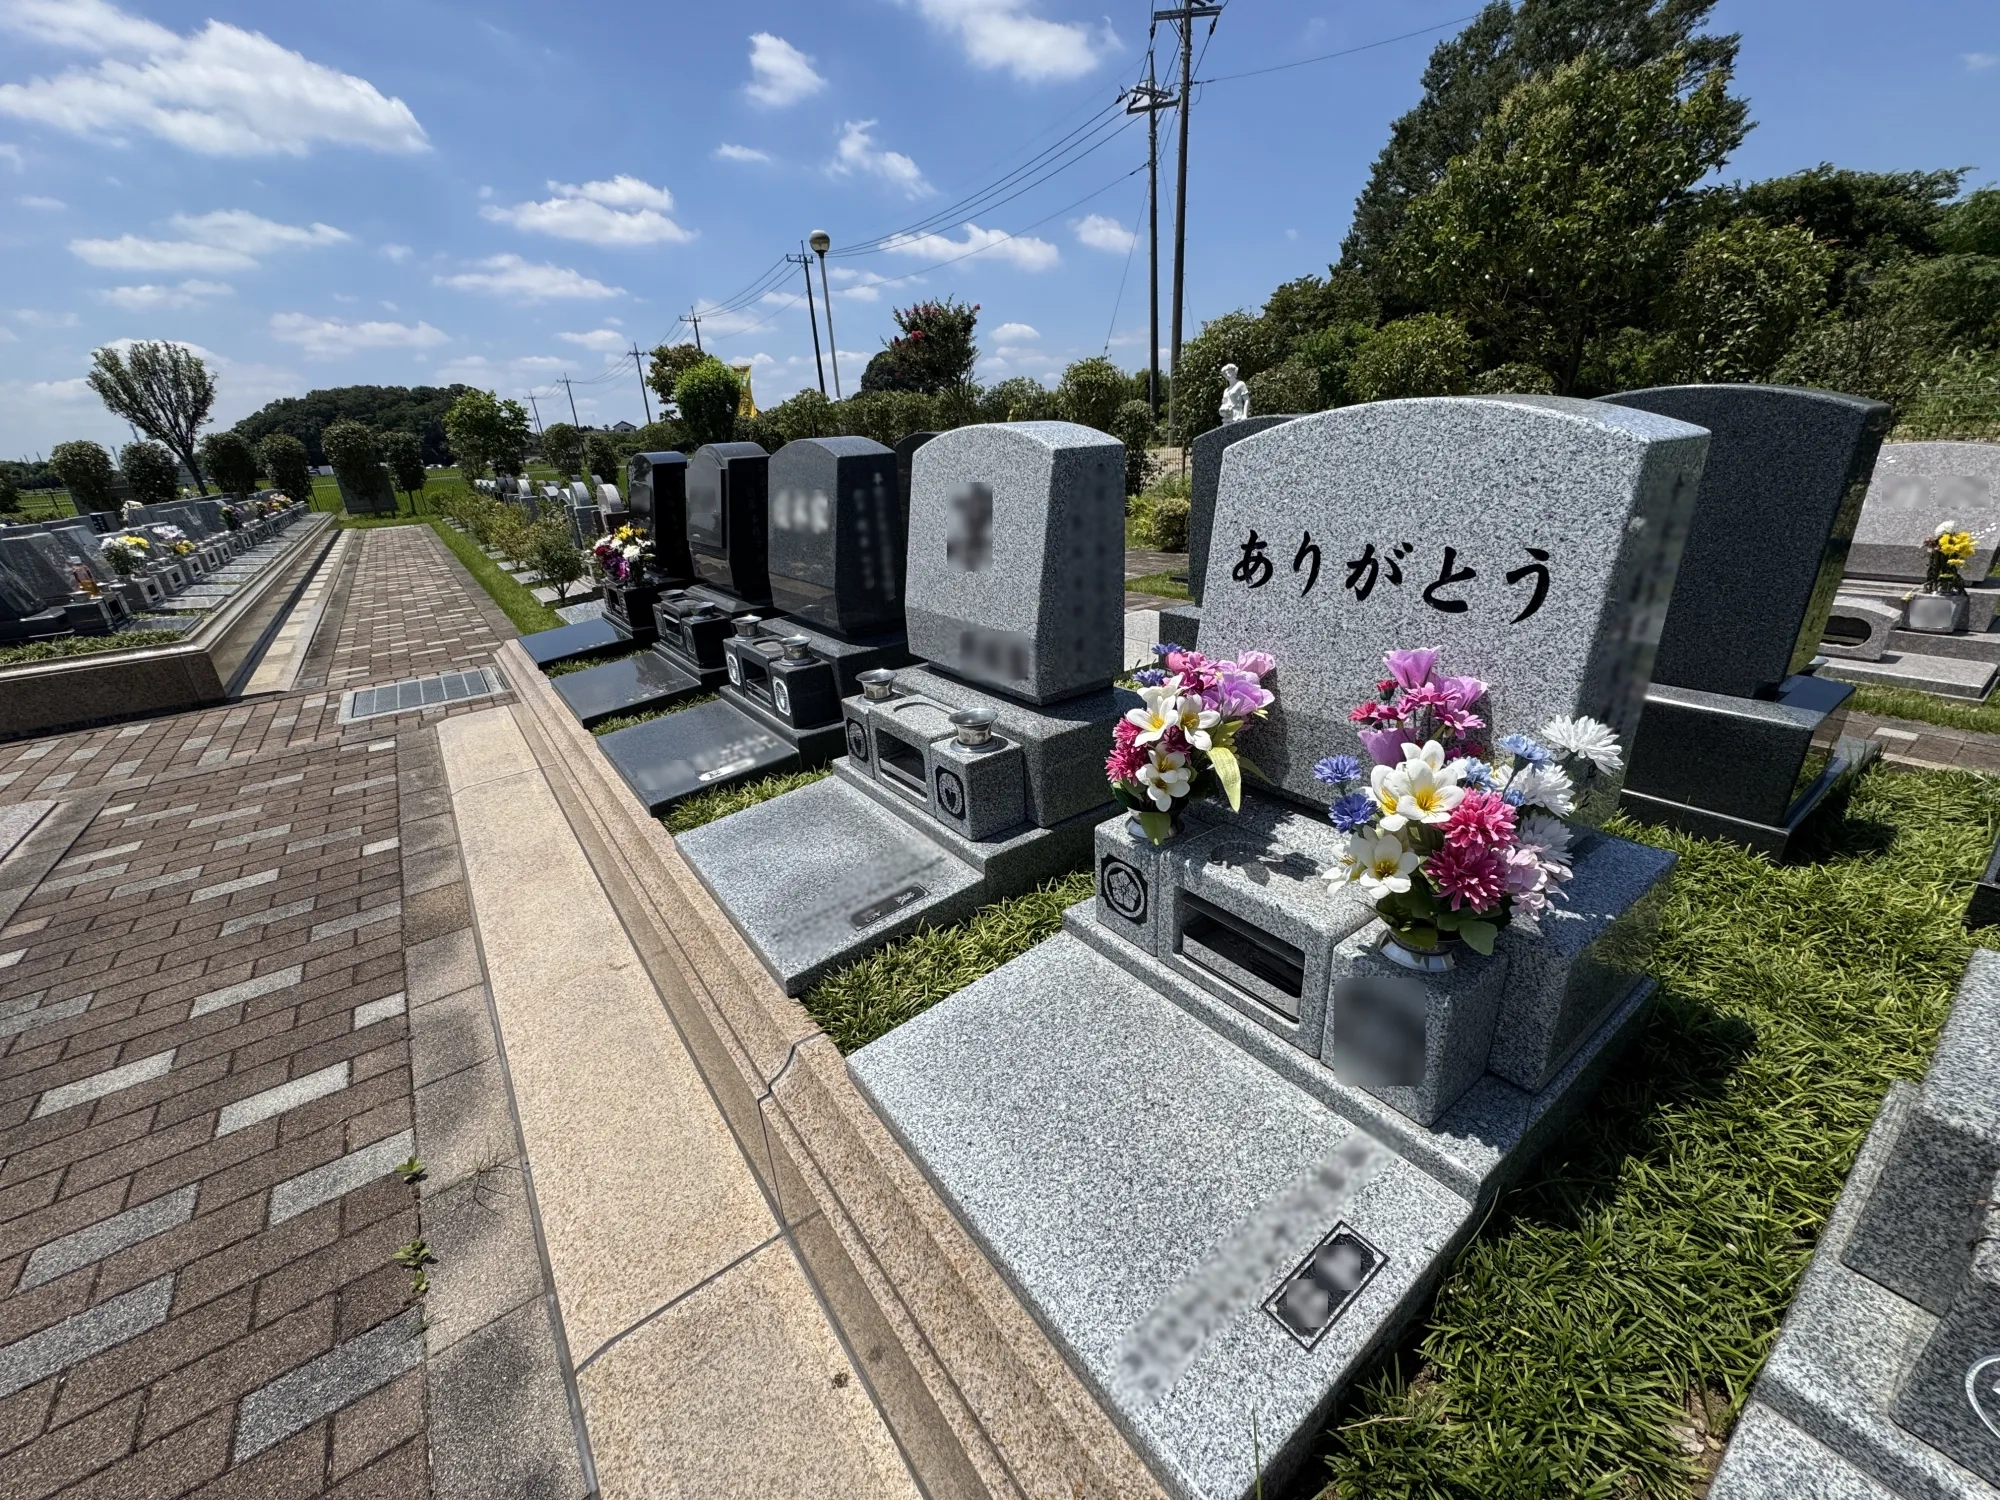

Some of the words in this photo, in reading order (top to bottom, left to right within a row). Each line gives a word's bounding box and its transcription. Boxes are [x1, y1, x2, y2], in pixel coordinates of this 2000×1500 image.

[1232, 529, 1551, 624] ありがとう
